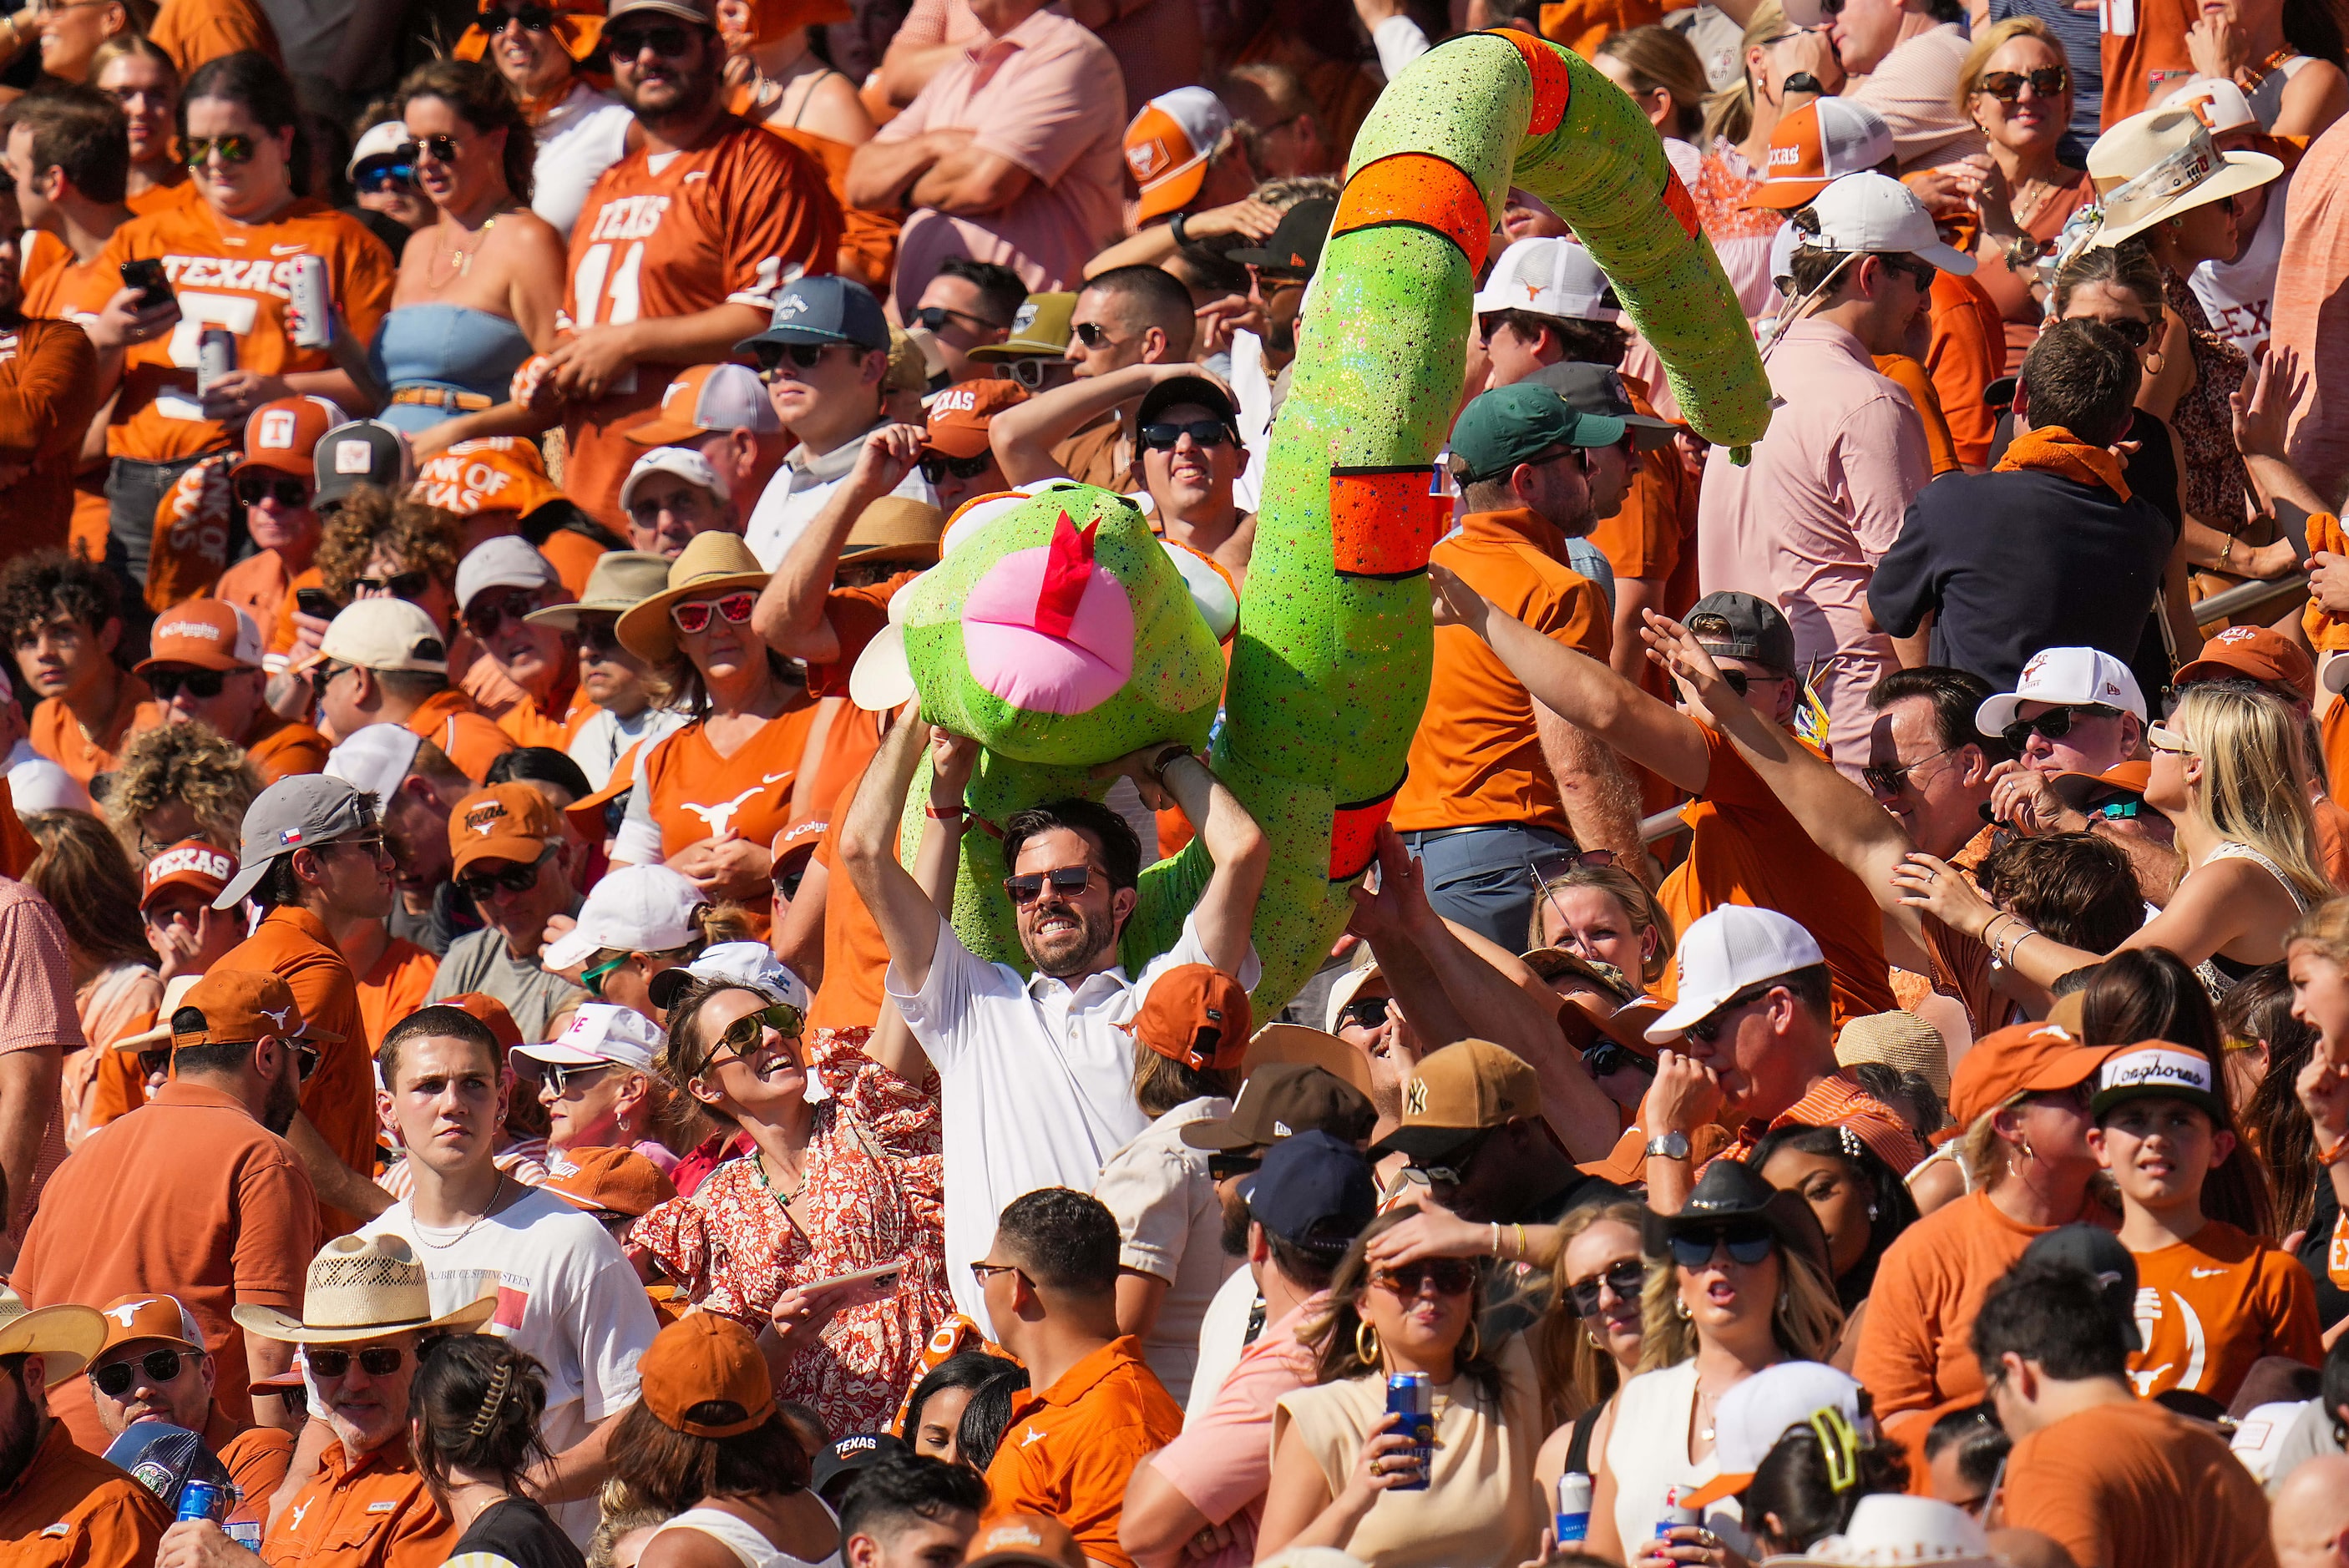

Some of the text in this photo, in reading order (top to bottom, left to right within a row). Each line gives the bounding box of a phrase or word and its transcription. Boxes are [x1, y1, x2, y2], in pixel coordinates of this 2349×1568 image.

[161, 255, 292, 299] TEXAS
[268, 418, 289, 440] T
[465, 463, 511, 496] OF
[464, 804, 508, 832] Texas
[149, 847, 230, 884] TEXAS
[2110, 1055, 2205, 1087] Longhorns
[471, 1268, 532, 1287] SPRINGSTEEN
[929, 1315, 961, 1353] OF
[836, 1436, 877, 1454] TEXAS
